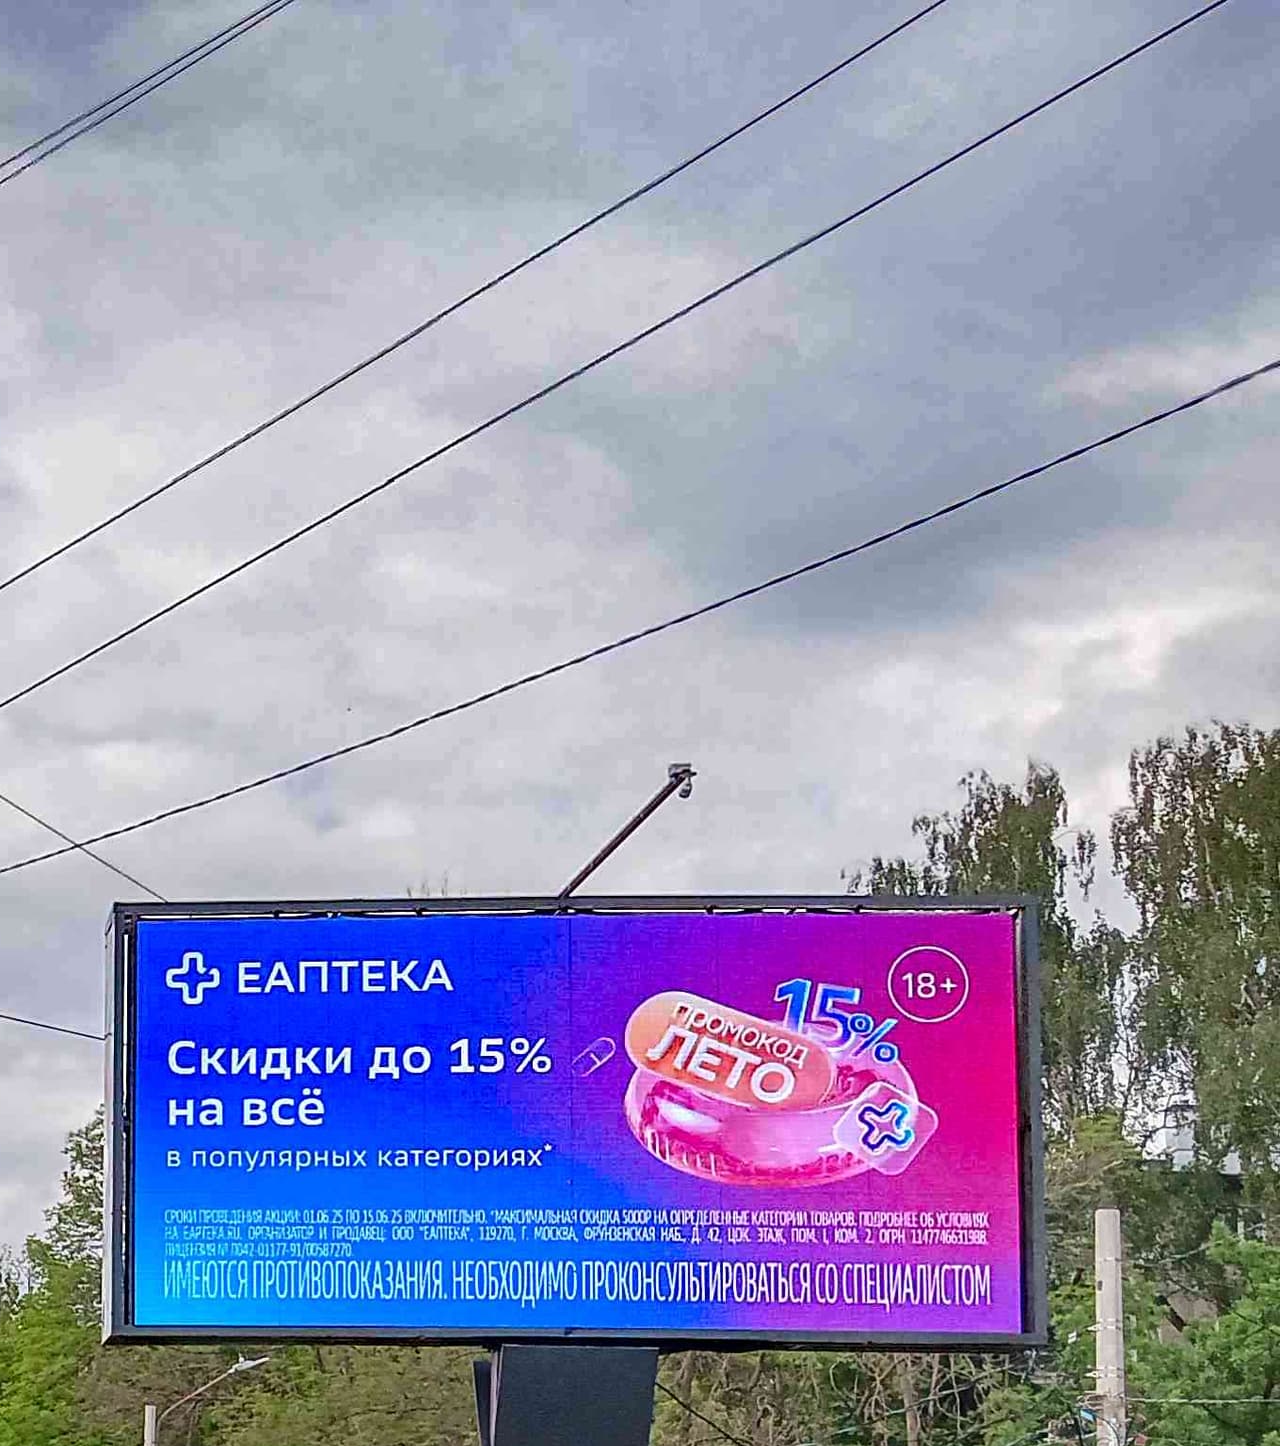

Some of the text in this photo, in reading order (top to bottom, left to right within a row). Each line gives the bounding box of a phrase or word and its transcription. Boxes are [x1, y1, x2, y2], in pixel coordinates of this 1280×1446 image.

[237, 959, 454, 993] ЕАПТЕКА
[901, 971, 958, 999] 18+
[671, 1001, 810, 1069] ПРОМОКОД
[774, 978, 900, 1064] 15%
[168, 1037, 553, 1081] Скидки до 15%
[646, 1026, 797, 1104] ЛЕТО
[168, 1088, 325, 1126] на всё
[166, 1151, 181, 1167] в
[192, 1149, 367, 1172] популярных
[346, 1209, 360, 1224] ПО
[654, 1210, 668, 1224] НА
[920, 1212, 935, 1227] ОБ
[163, 1260, 991, 1313] ИМЕЮТСЯ ПРОТИВОПОКАЗАНИЯ. НЕОБХОДИМО ПРОКОНСУЛЬТИРОВАТЬСЯ СО СПЕЦИАЛИСТОМ
